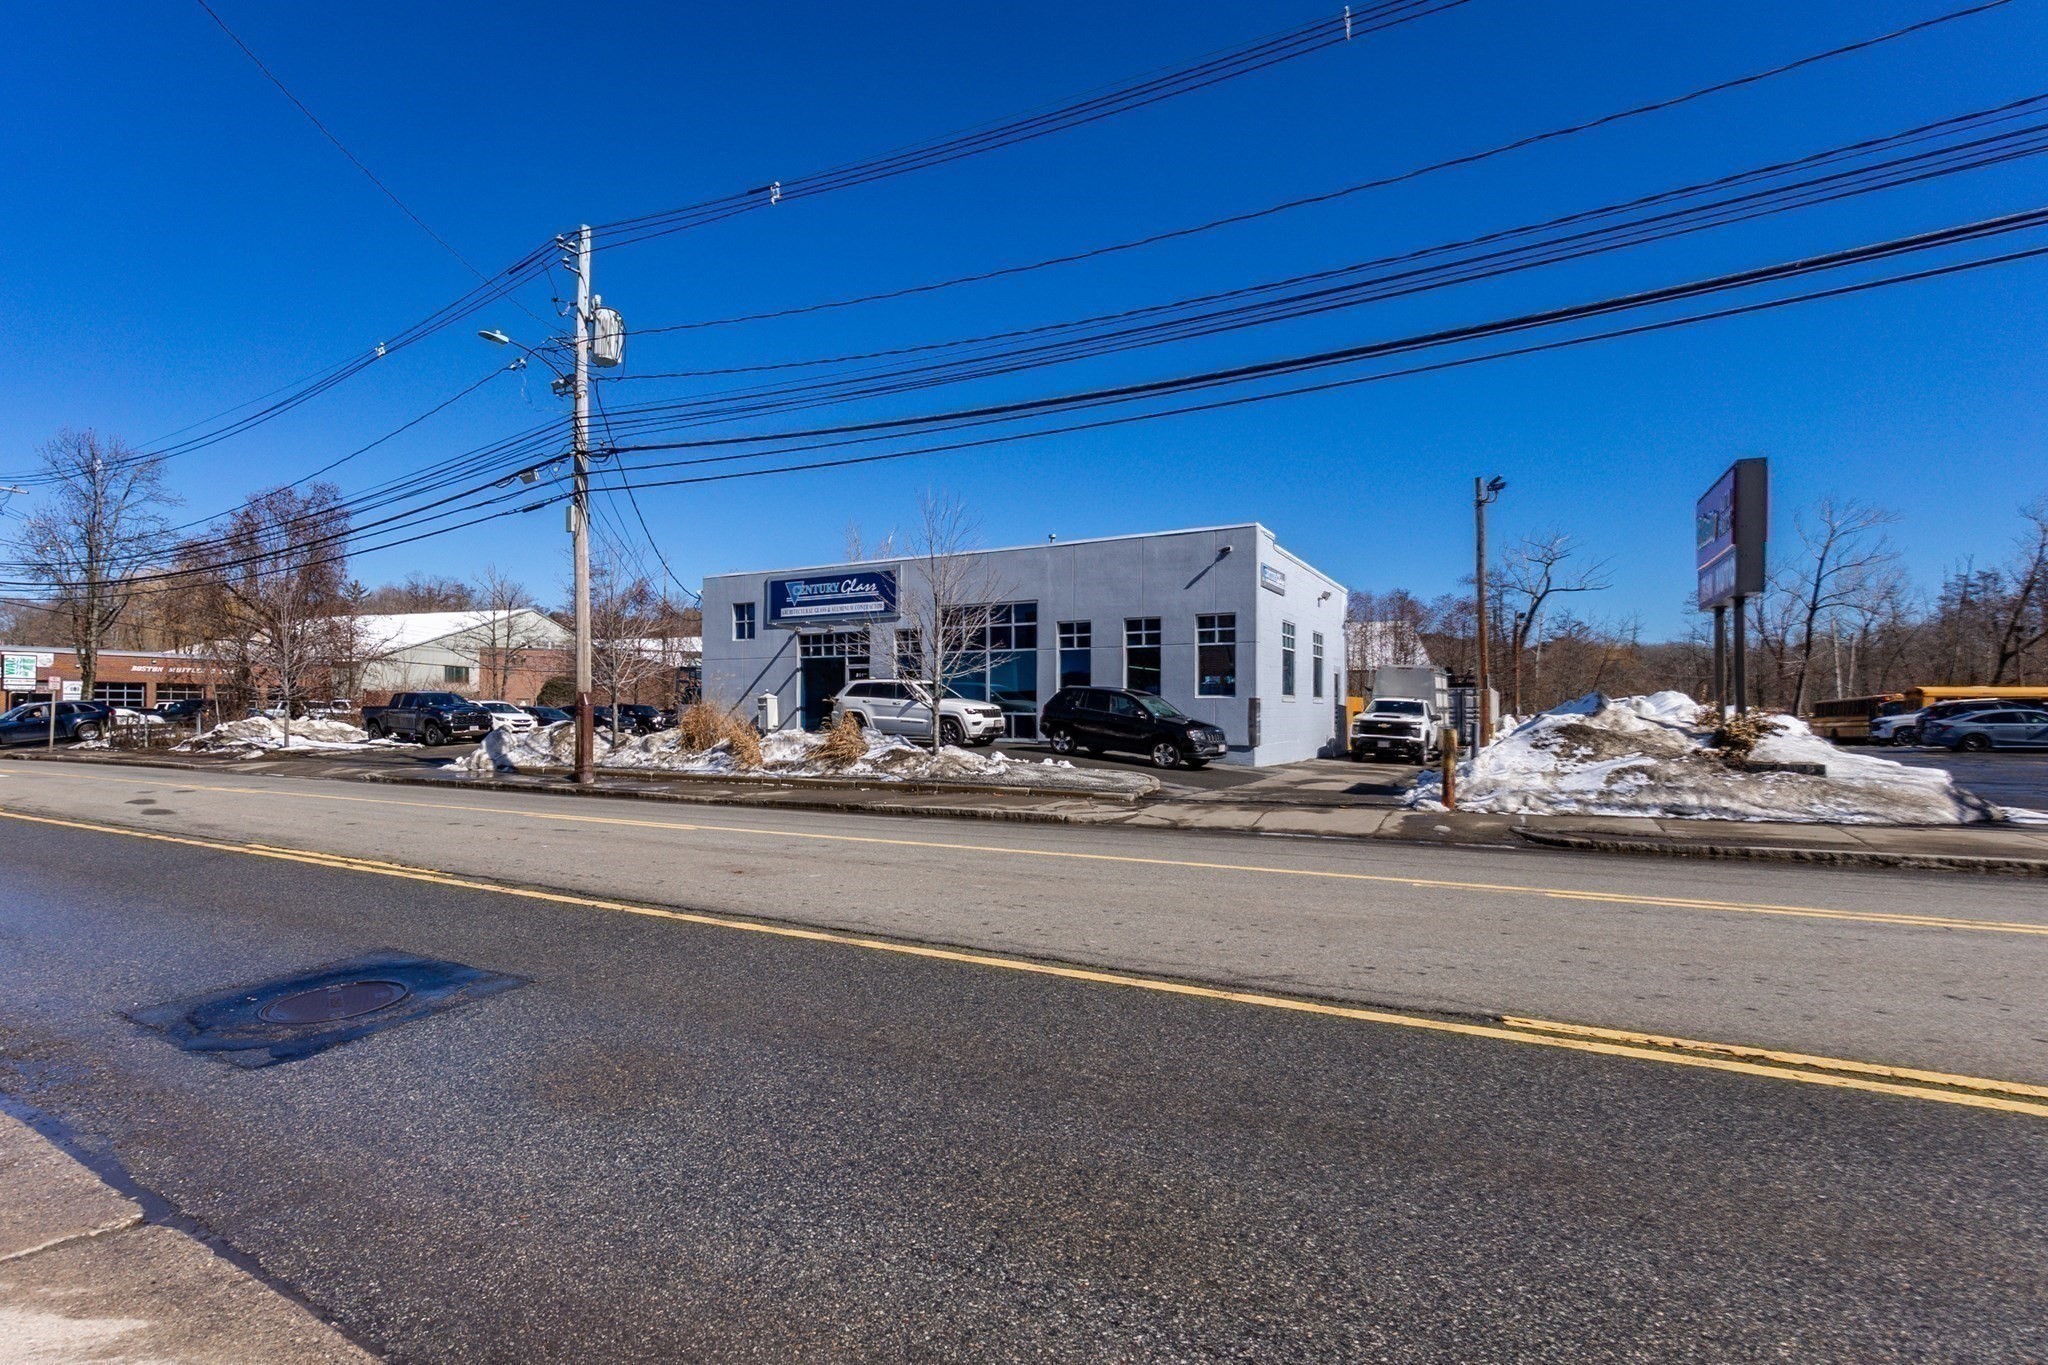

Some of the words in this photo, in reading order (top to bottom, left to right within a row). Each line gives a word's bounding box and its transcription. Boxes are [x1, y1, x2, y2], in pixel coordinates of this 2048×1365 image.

[793, 582, 840, 595] CENTURY
[841, 579, 877, 594] Glass
[131, 665, 164, 673] BOSTON
